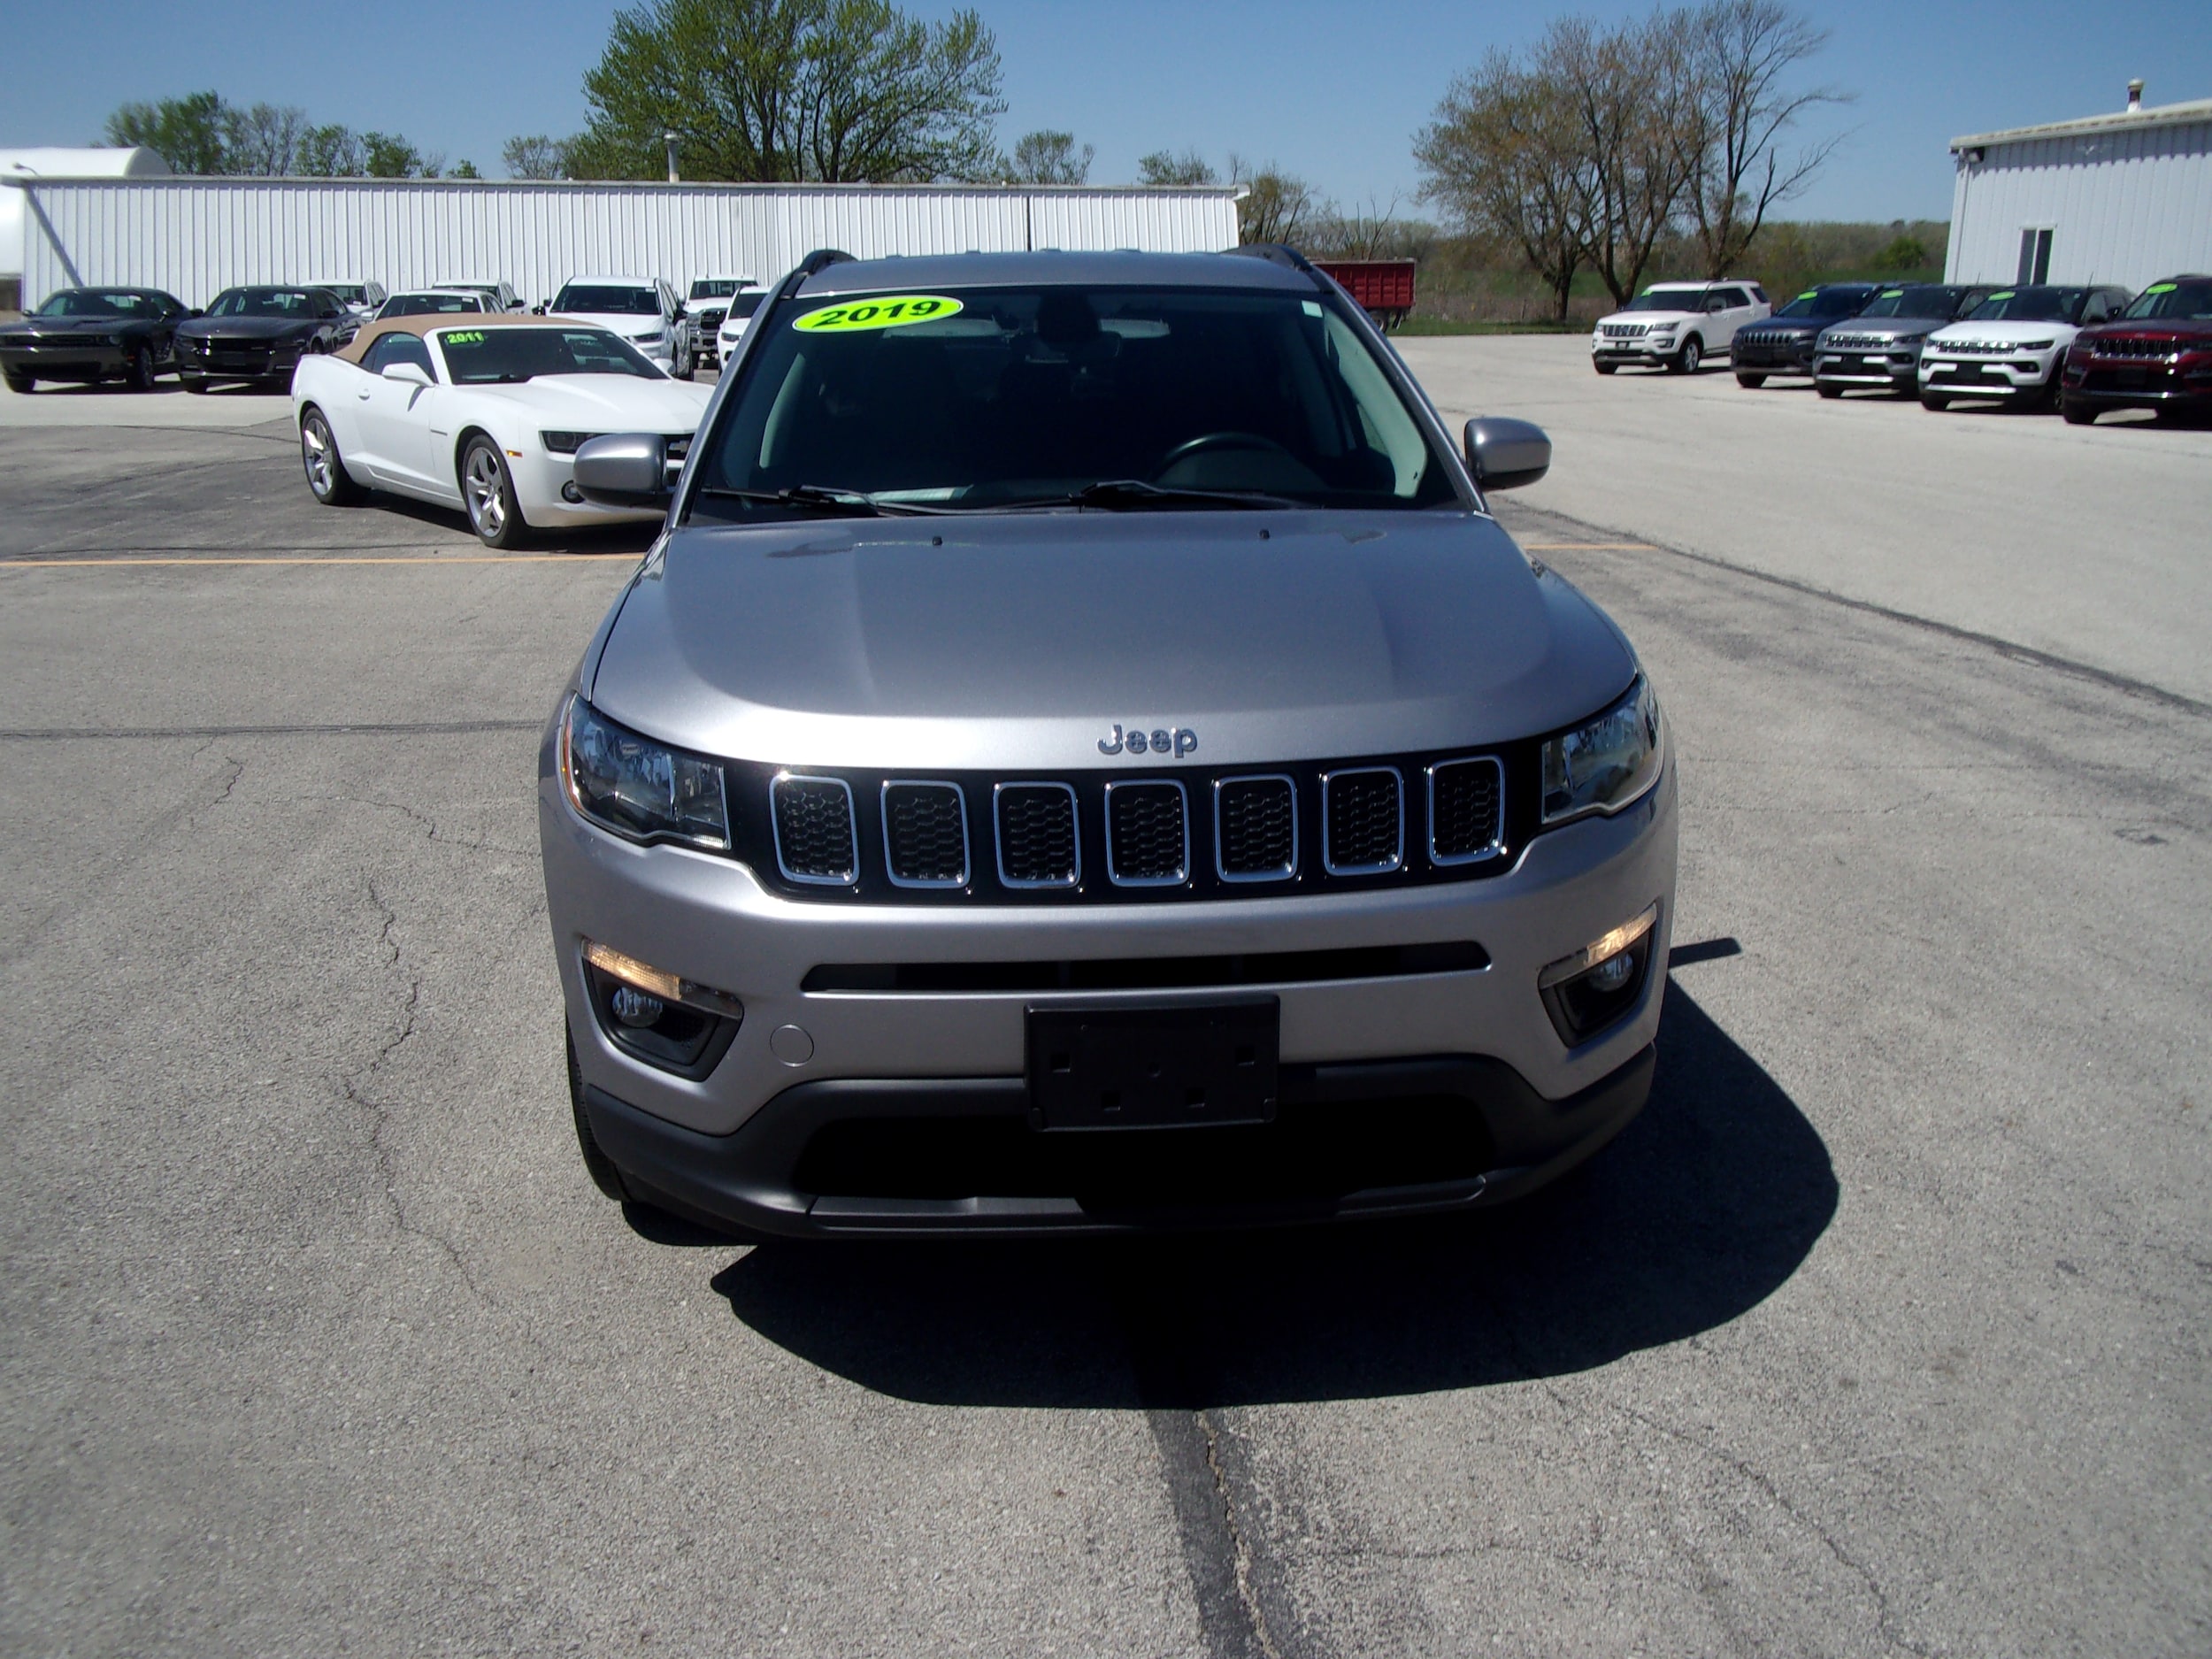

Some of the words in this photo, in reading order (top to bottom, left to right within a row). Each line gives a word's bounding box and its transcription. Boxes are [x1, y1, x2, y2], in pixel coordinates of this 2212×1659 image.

[812, 300, 942, 328] 2019
[447, 332, 484, 344] 2011
[1097, 724, 1197, 758] Jeep
